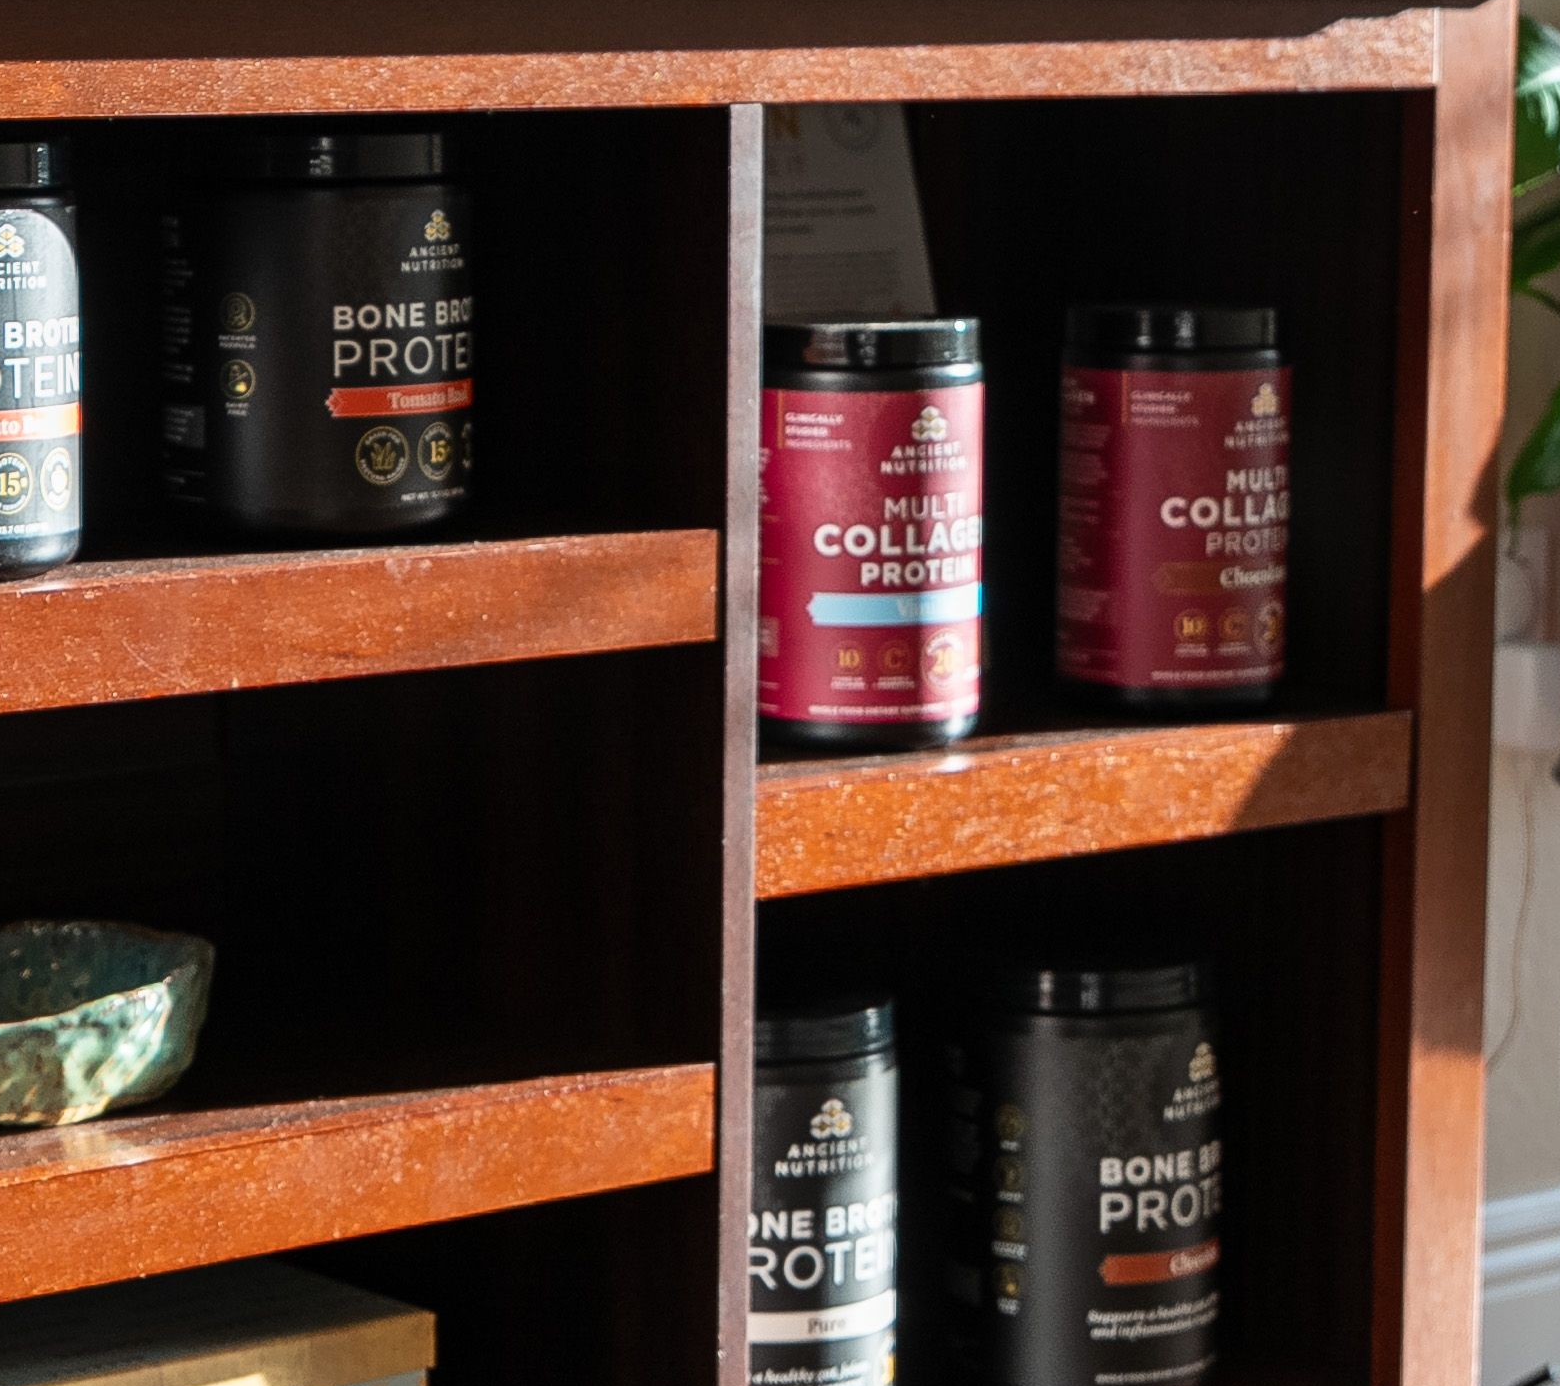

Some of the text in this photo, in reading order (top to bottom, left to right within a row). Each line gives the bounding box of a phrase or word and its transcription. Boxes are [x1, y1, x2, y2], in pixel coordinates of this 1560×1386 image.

[409, 244, 459, 258] ANCIENT
[333, 297, 473, 330] BONE BRO
[333, 332, 469, 378] PROTE
[891, 441, 961, 458] ANCIENT
[884, 491, 967, 520] MULTI
[813, 515, 982, 557] COLLAGE
[861, 554, 974, 586] PROTEIN
[1099, 1150, 1195, 1187] BONE
[807, 1317, 847, 1334] Pure
